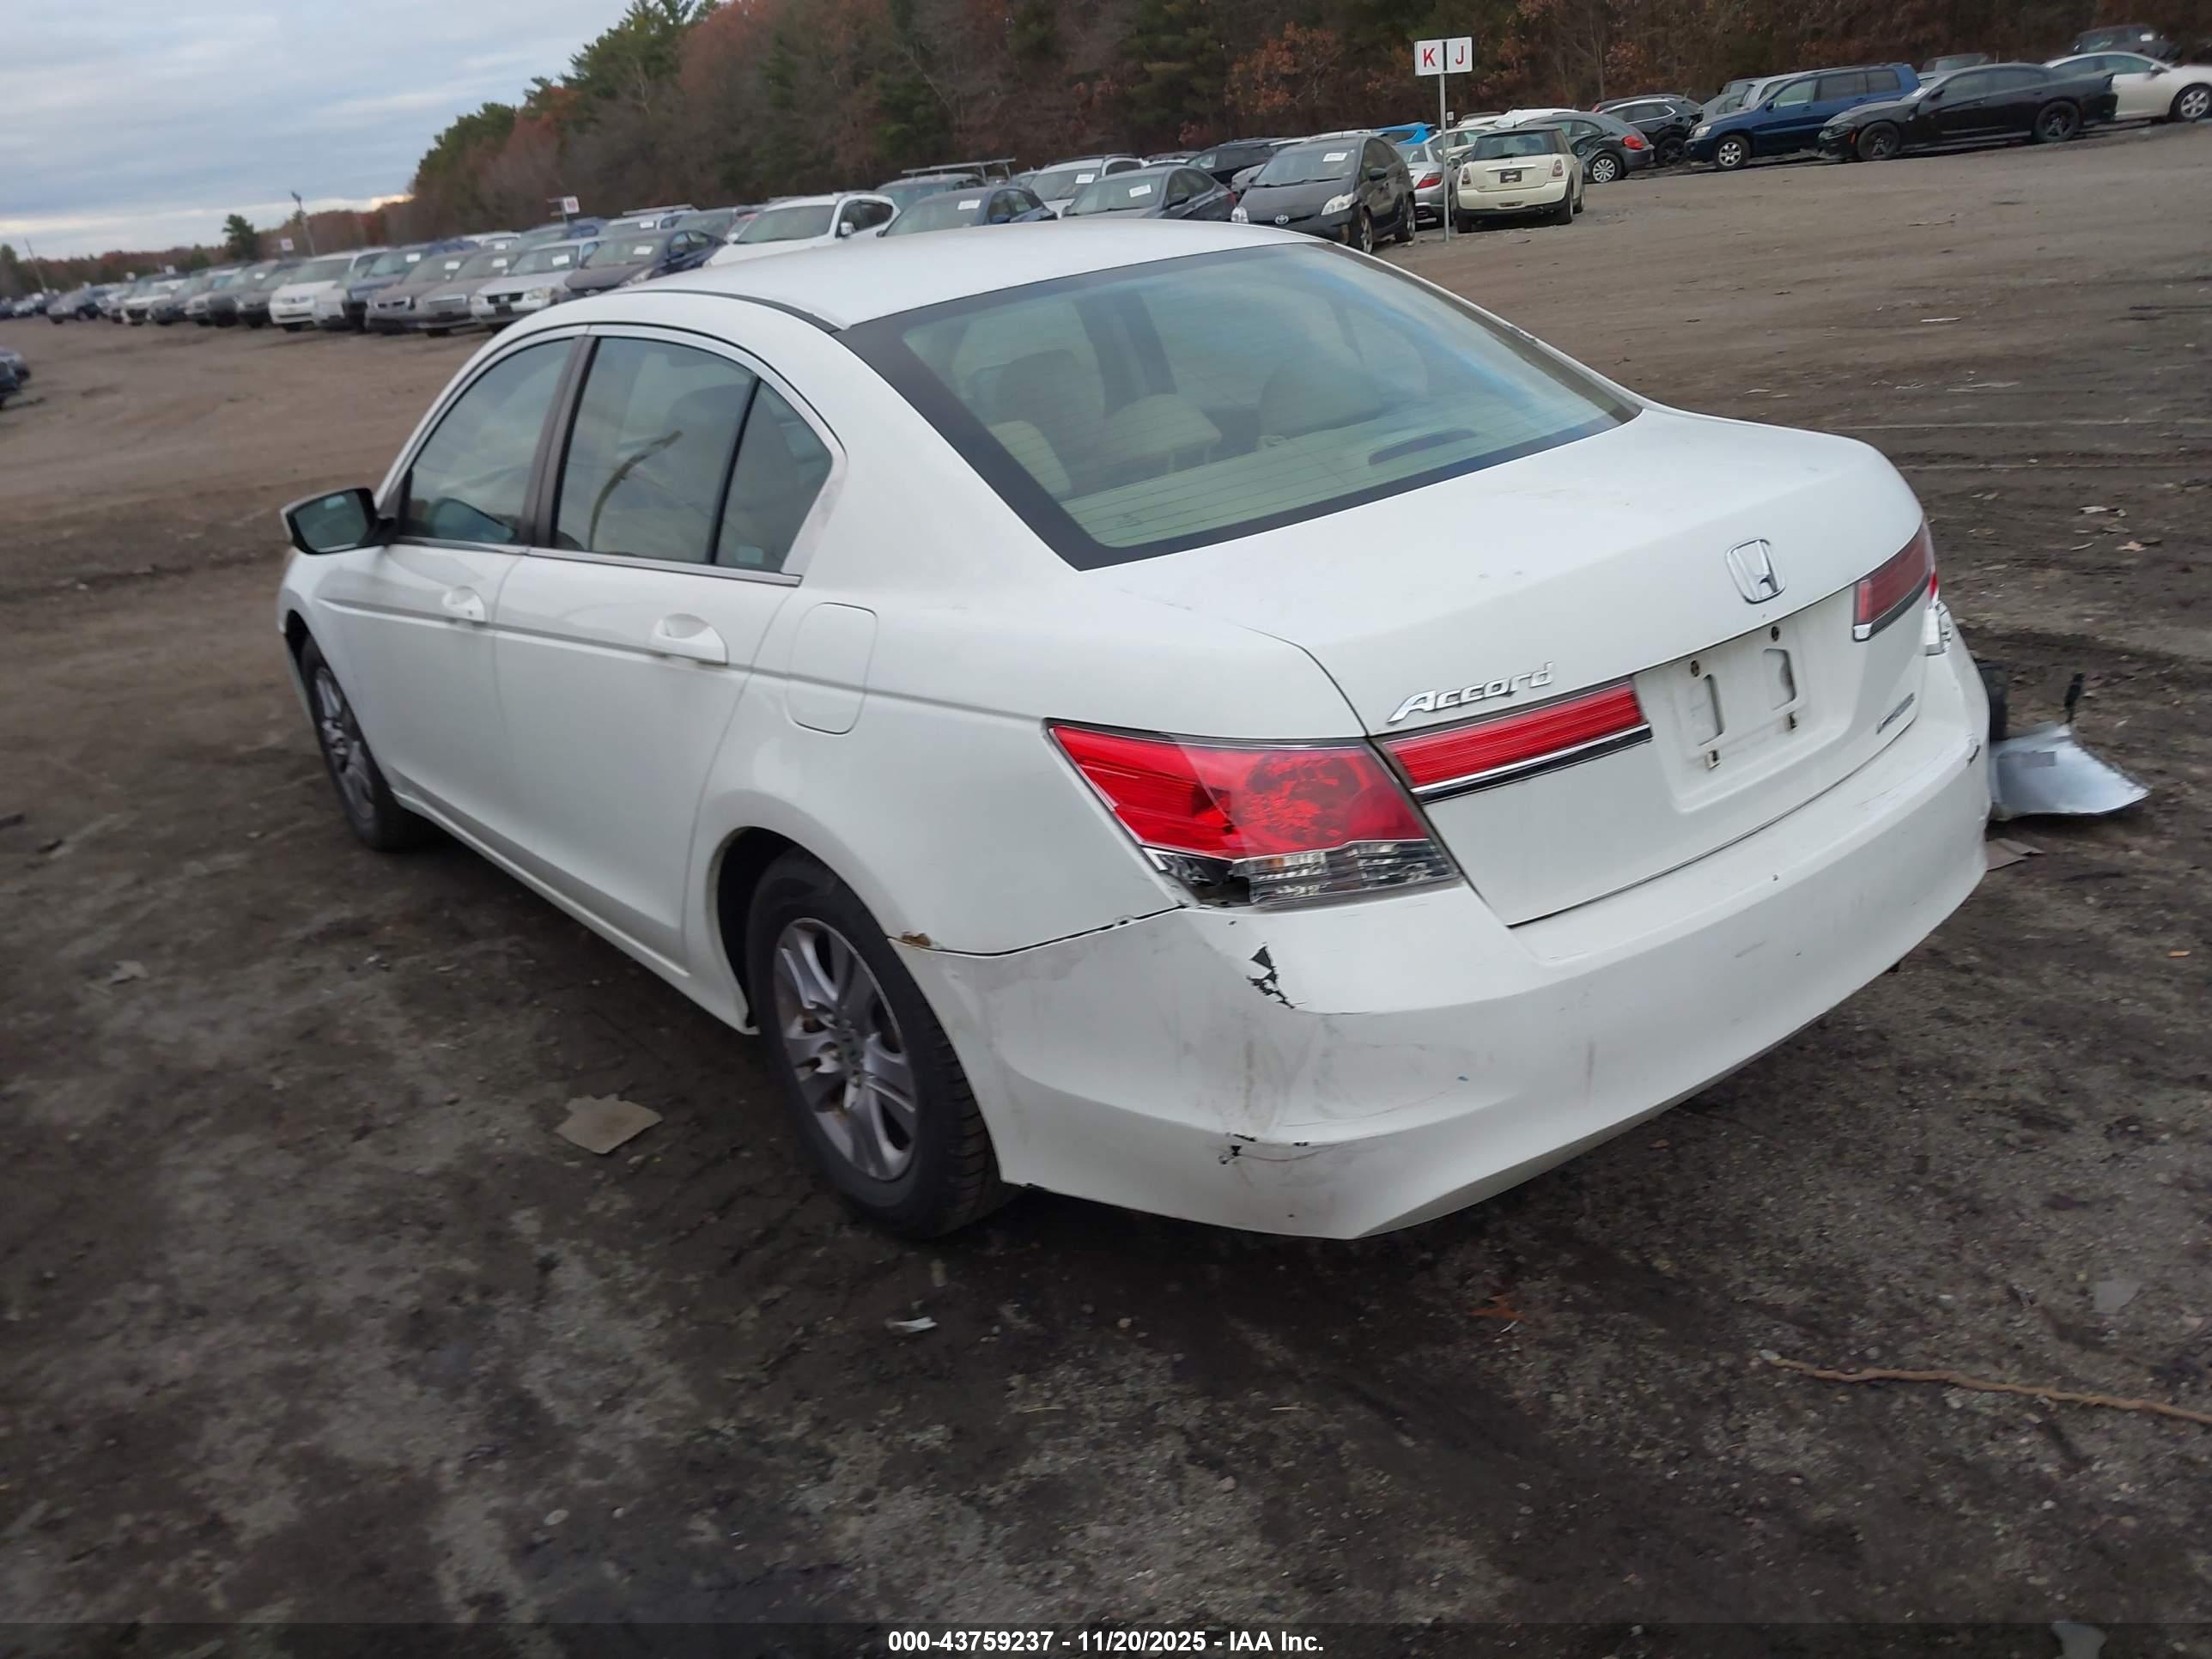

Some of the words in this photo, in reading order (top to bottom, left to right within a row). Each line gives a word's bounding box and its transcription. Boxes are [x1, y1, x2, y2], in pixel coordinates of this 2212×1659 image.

[1422, 47, 1437, 68] K
[1455, 45, 1465, 65] J
[1387, 660, 1553, 724] Accord
